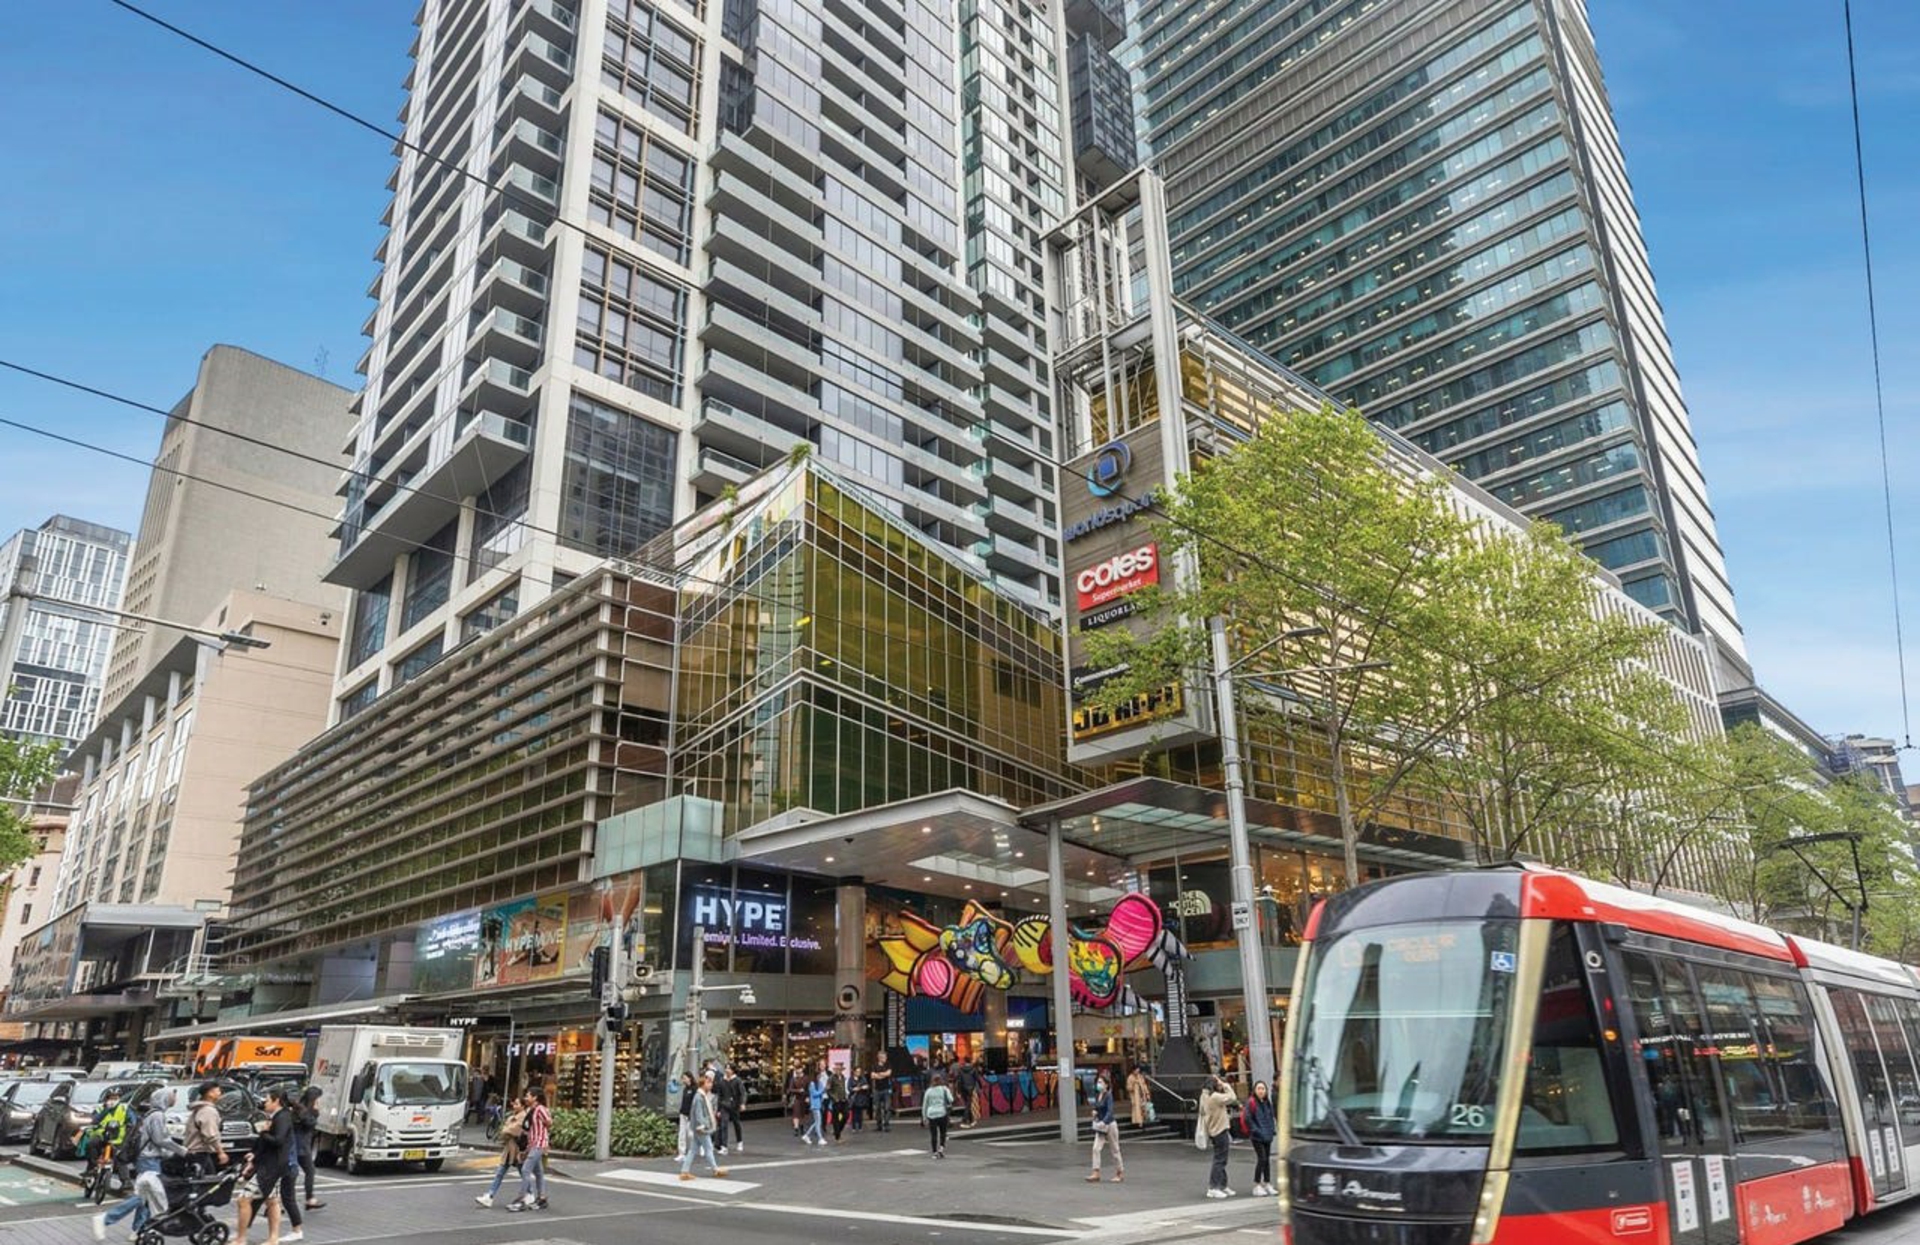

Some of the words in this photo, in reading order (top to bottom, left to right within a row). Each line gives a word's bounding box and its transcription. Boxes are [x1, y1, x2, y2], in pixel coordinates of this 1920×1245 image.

[1077, 546, 1154, 593] coles
[694, 896, 782, 931] HYPE
[741, 932, 778, 948] Limited.
[779, 936, 822, 951] Eclusive.
[450, 1017, 479, 1026] HYPE
[1452, 1104, 1485, 1127] 26
